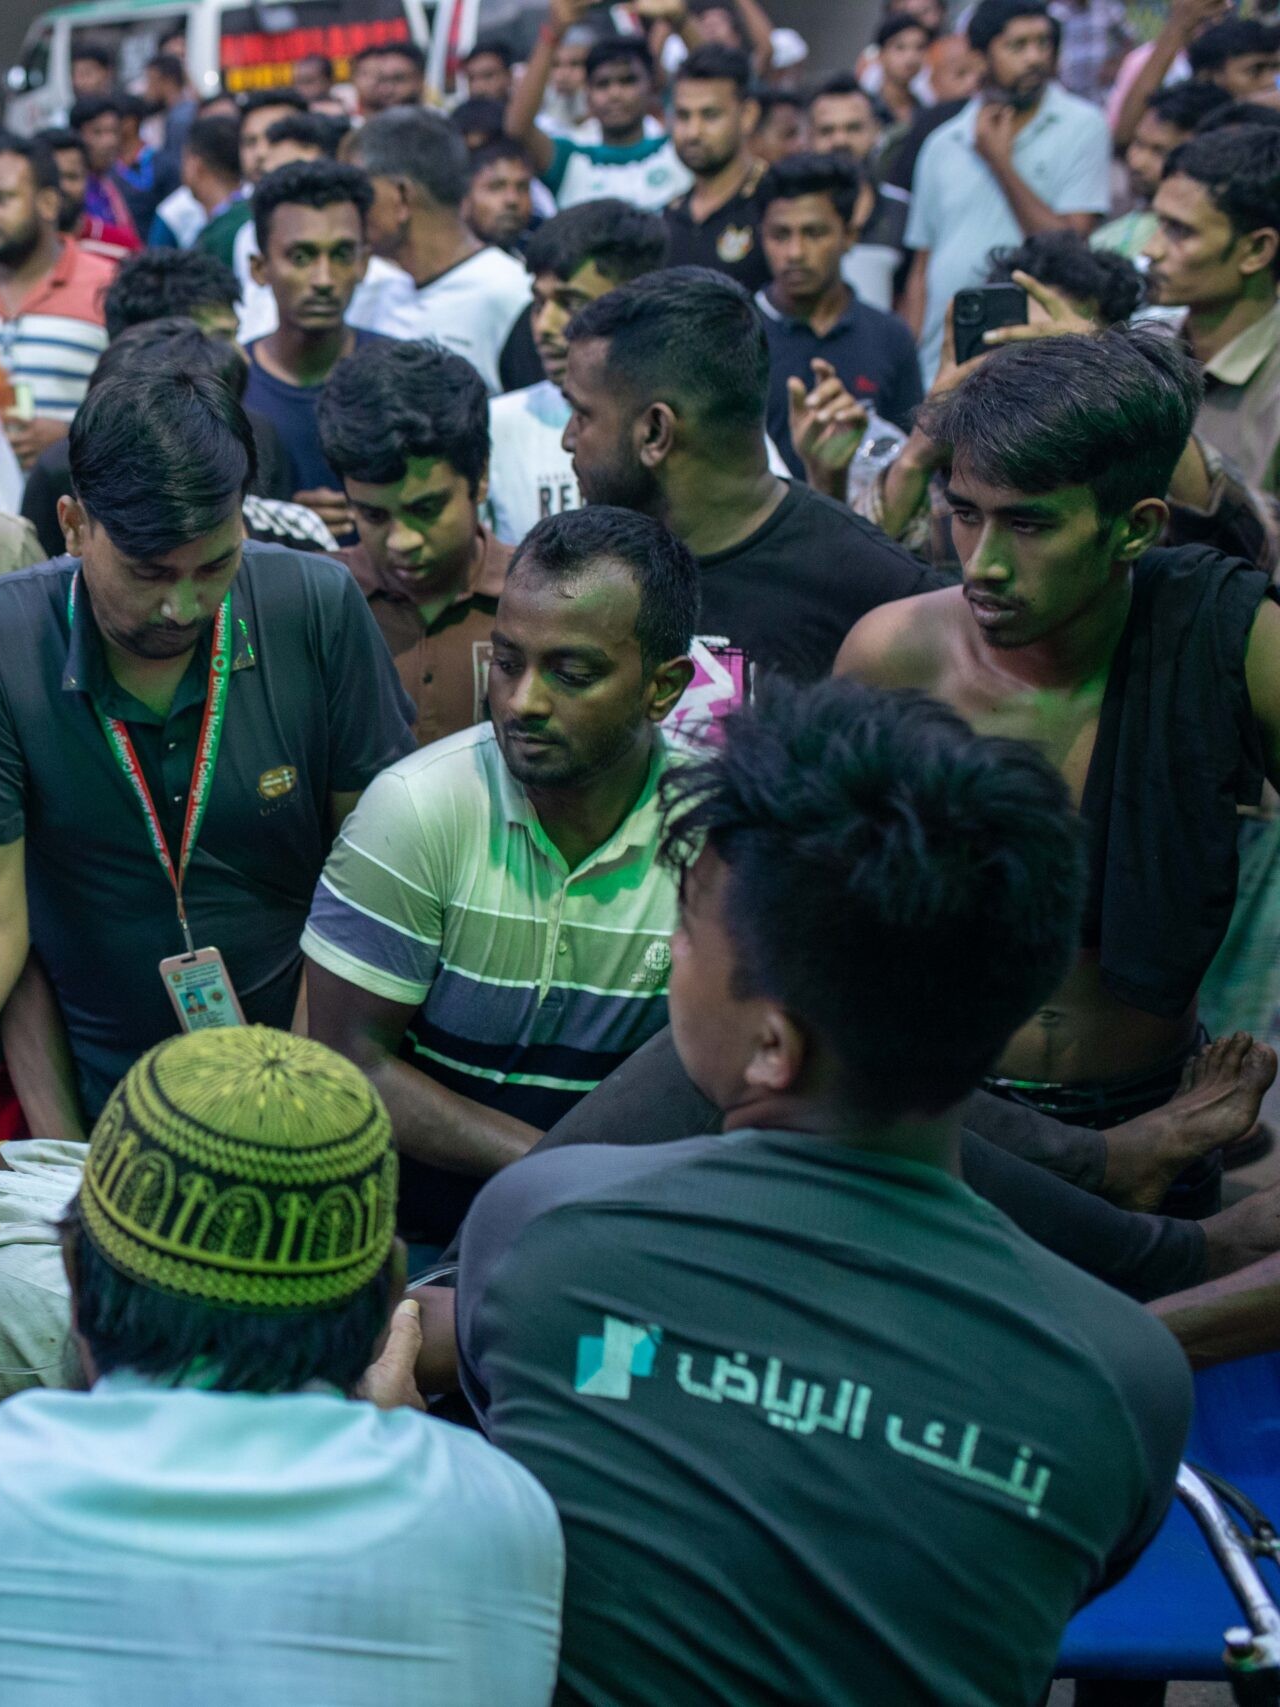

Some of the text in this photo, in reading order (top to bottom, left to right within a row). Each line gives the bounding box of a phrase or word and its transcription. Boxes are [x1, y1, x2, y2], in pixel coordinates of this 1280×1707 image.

[538, 484, 586, 519] RE
[215, 602, 229, 651] Hospital
[209, 676, 225, 712] Dhaka
[112, 730, 135, 772] College
[201, 714, 220, 759] Medical
[192, 761, 212, 802] College
[676, 1351, 873, 1440] الرياض
